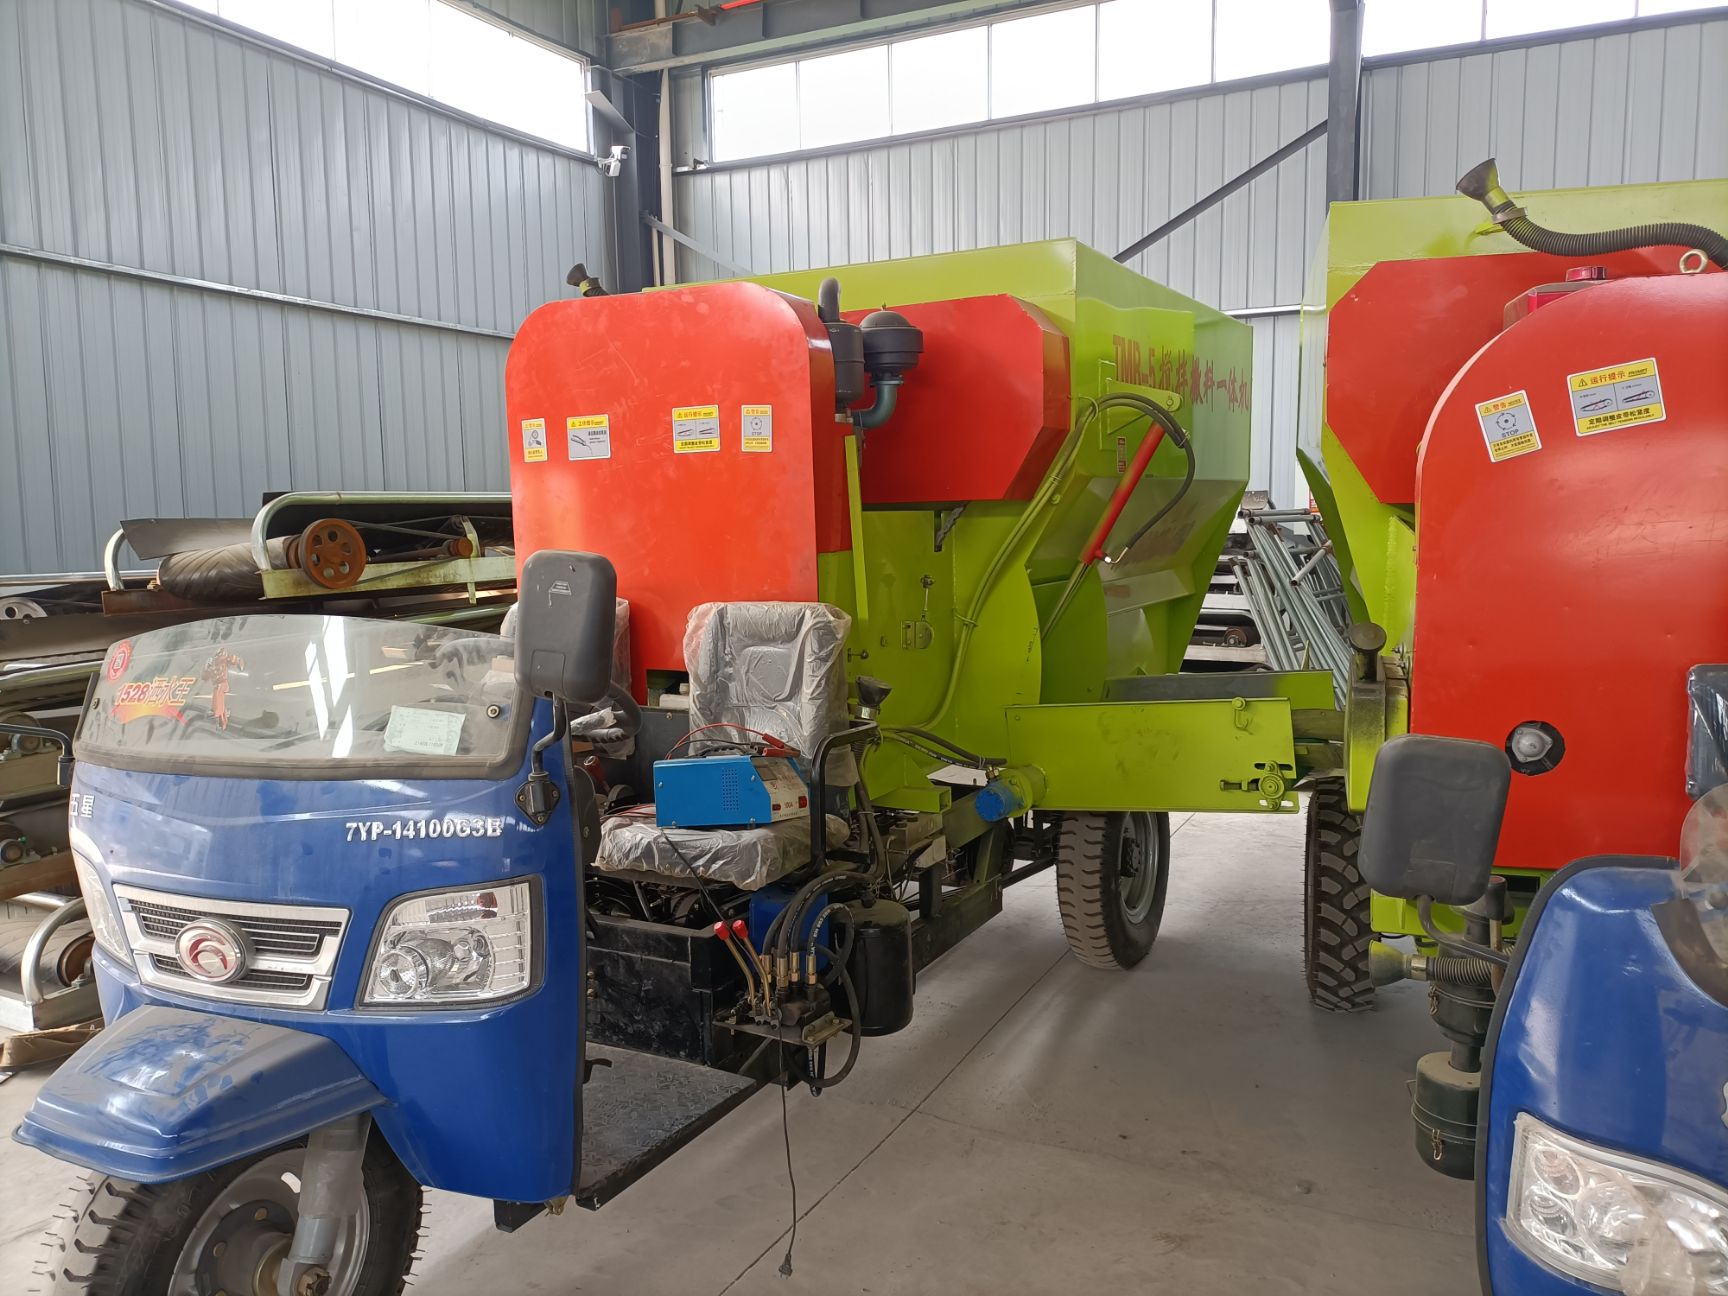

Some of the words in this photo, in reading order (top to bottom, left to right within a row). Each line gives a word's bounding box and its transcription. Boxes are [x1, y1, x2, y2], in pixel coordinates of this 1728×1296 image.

[1590, 372, 1625, 385] 运行提示
[1502, 429, 1519, 437] STOP
[346, 817, 501, 842] 7YP-14100G3B
